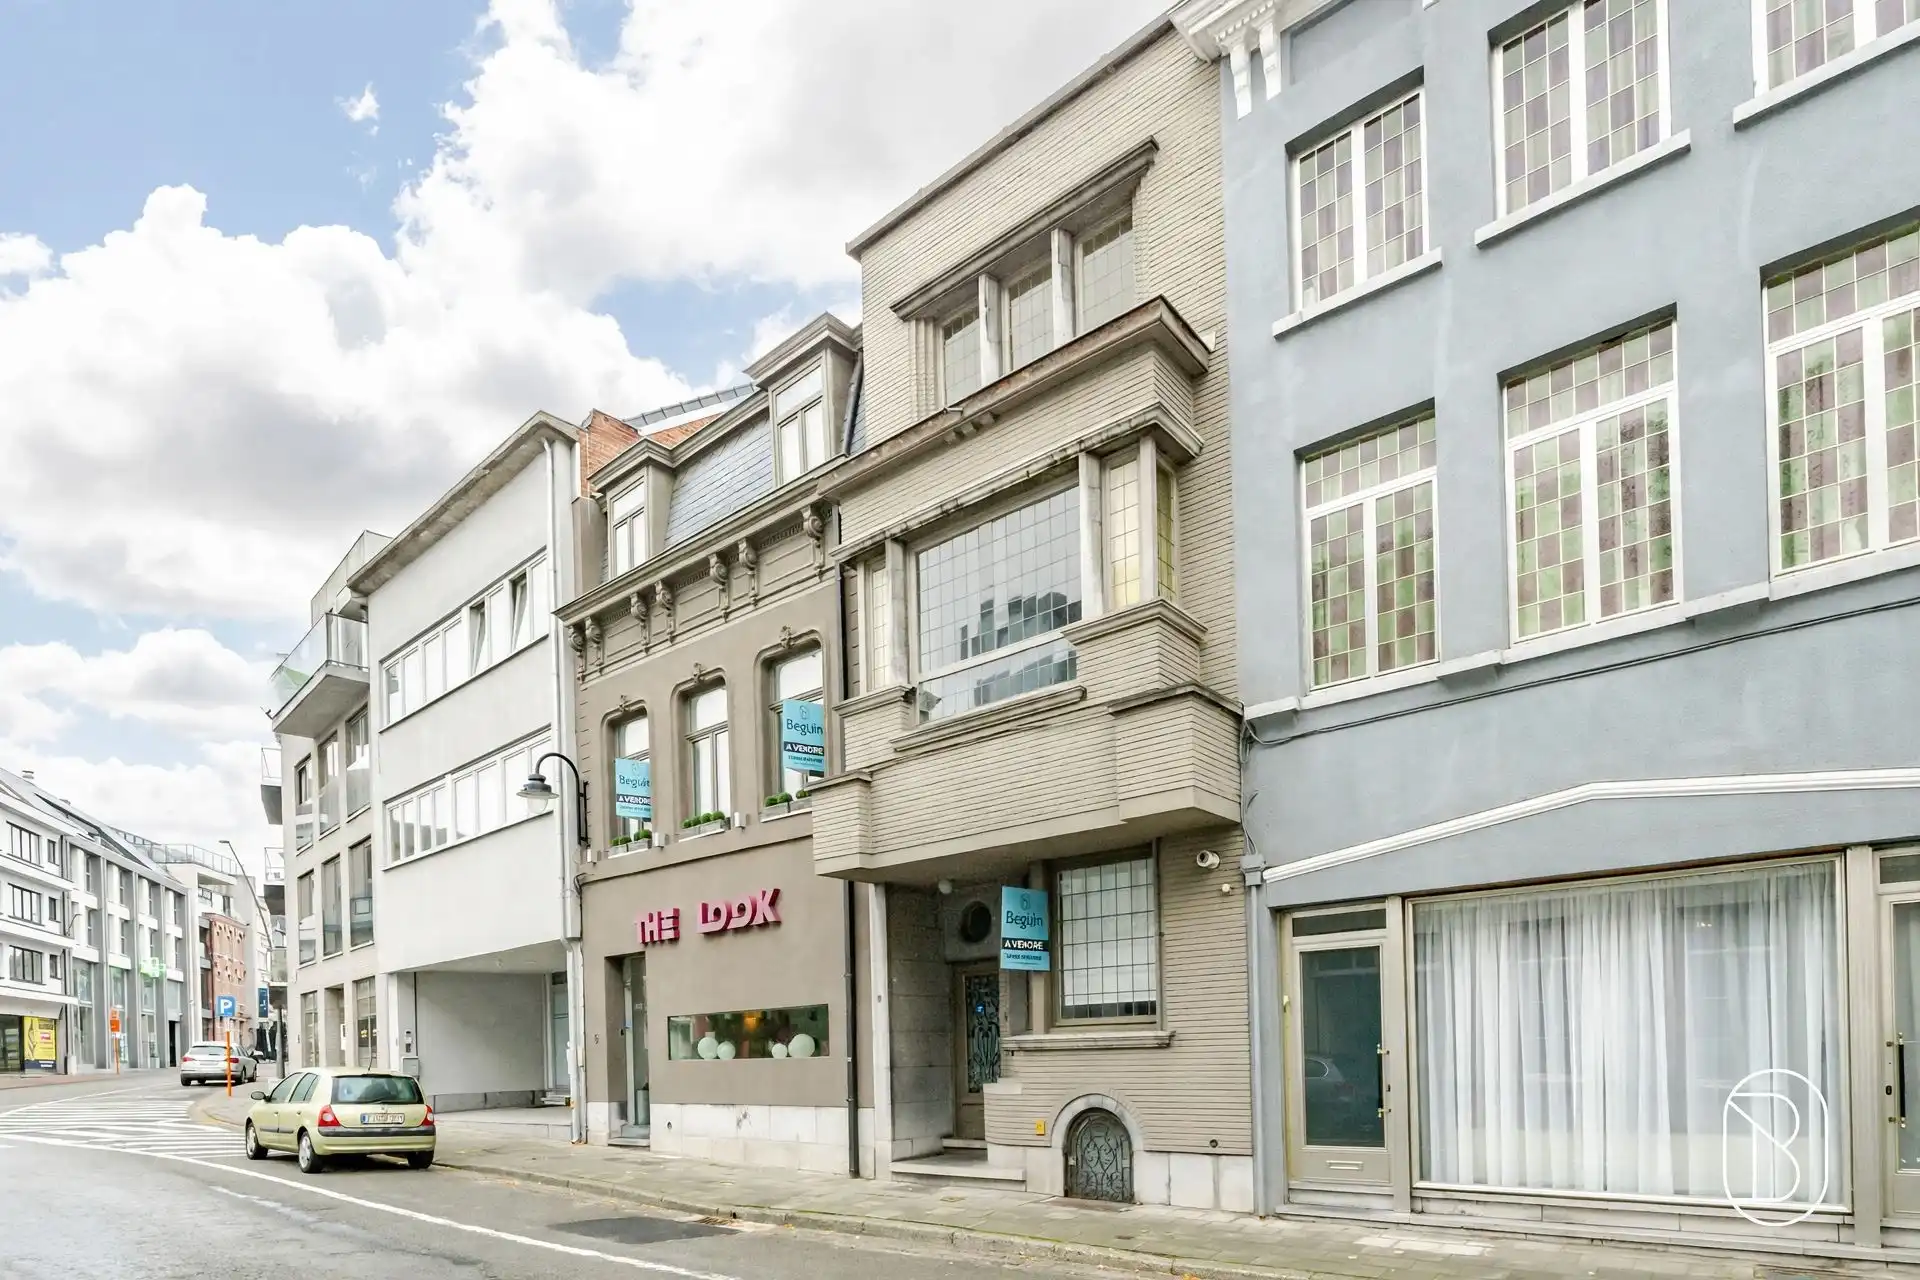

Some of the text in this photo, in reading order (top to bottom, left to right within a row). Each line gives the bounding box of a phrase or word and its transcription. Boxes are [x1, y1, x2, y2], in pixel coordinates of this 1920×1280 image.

[786, 719, 823, 735] Beguin
[793, 745, 823, 755] VENDRE
[634, 888, 781, 945] THE LOOK
[1006, 911, 1043, 929] Beguin
[1012, 940, 1044, 950] VENDRE
[220, 998, 233, 1014] P
